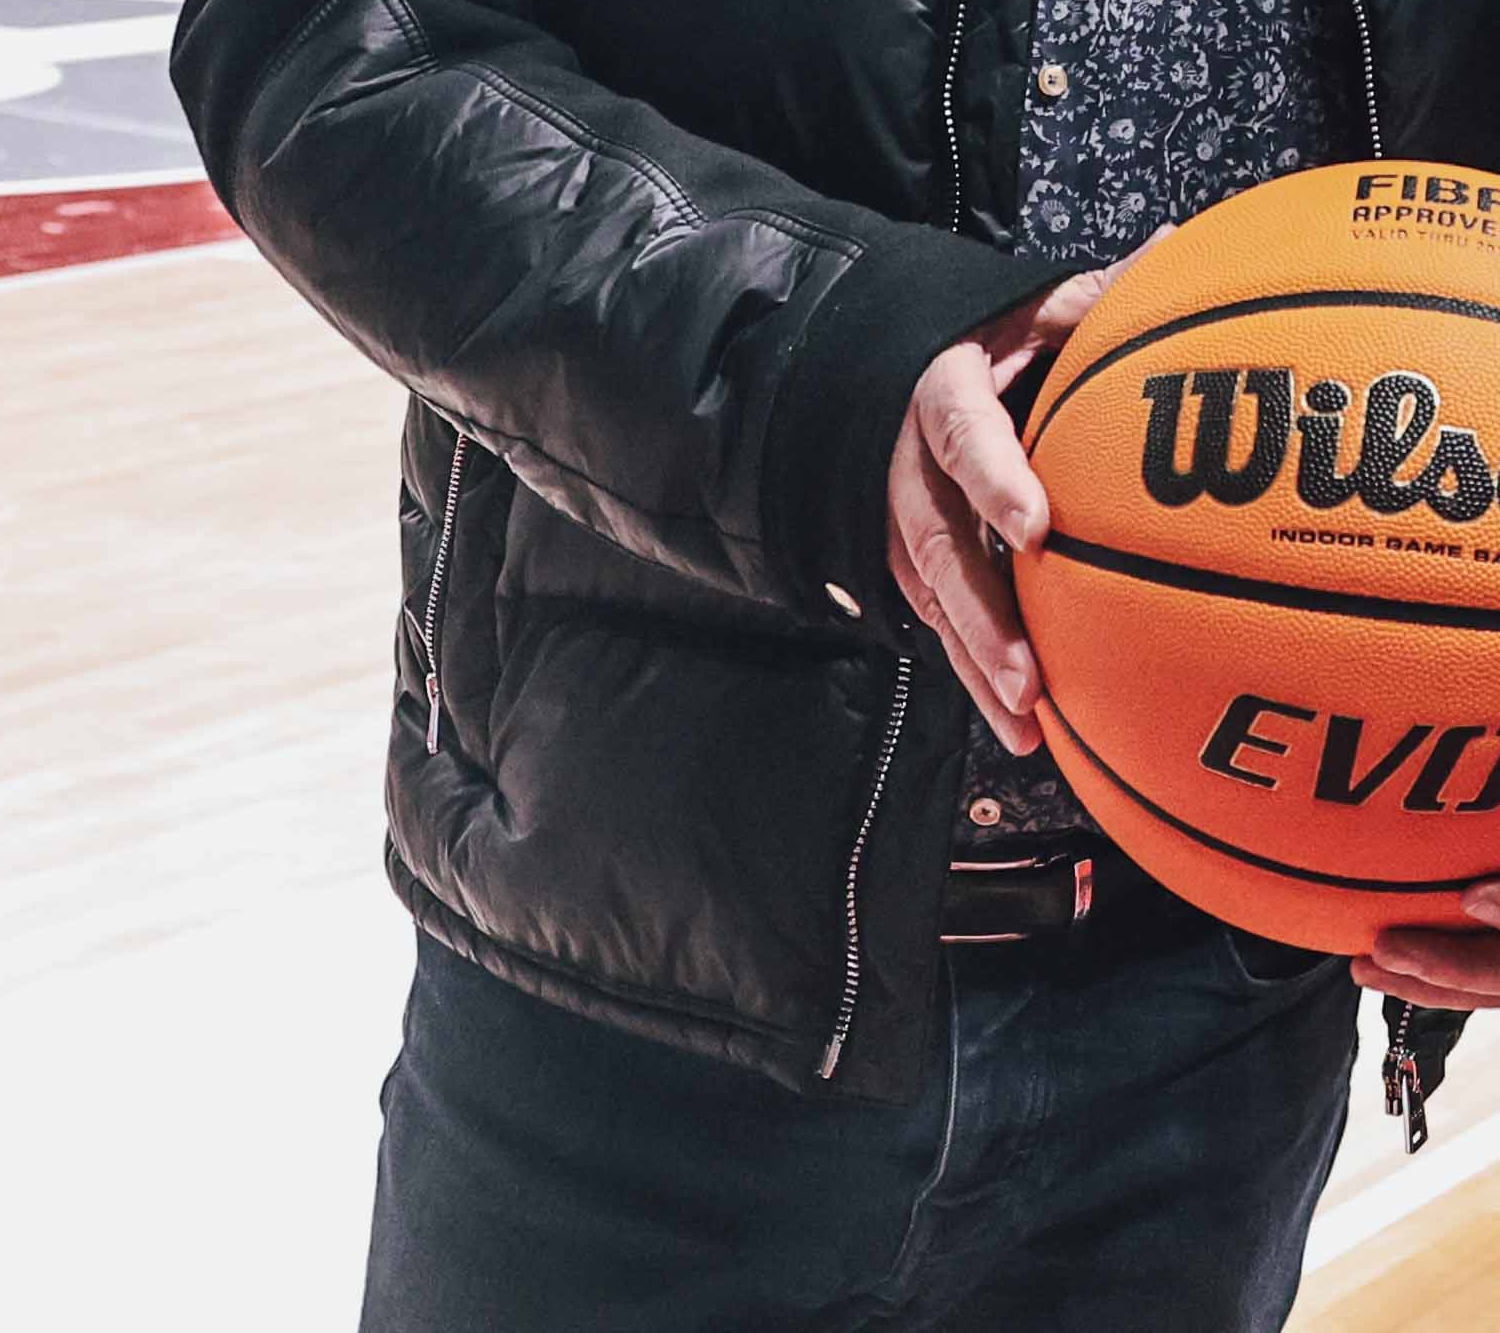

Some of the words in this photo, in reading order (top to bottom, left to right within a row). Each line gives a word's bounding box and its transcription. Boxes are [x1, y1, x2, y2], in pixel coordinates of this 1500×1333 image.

[1352, 228, 1409, 241] VALID
[1271, 528, 1375, 548] INDOOR
[1384, 540, 1462, 559] GAME
